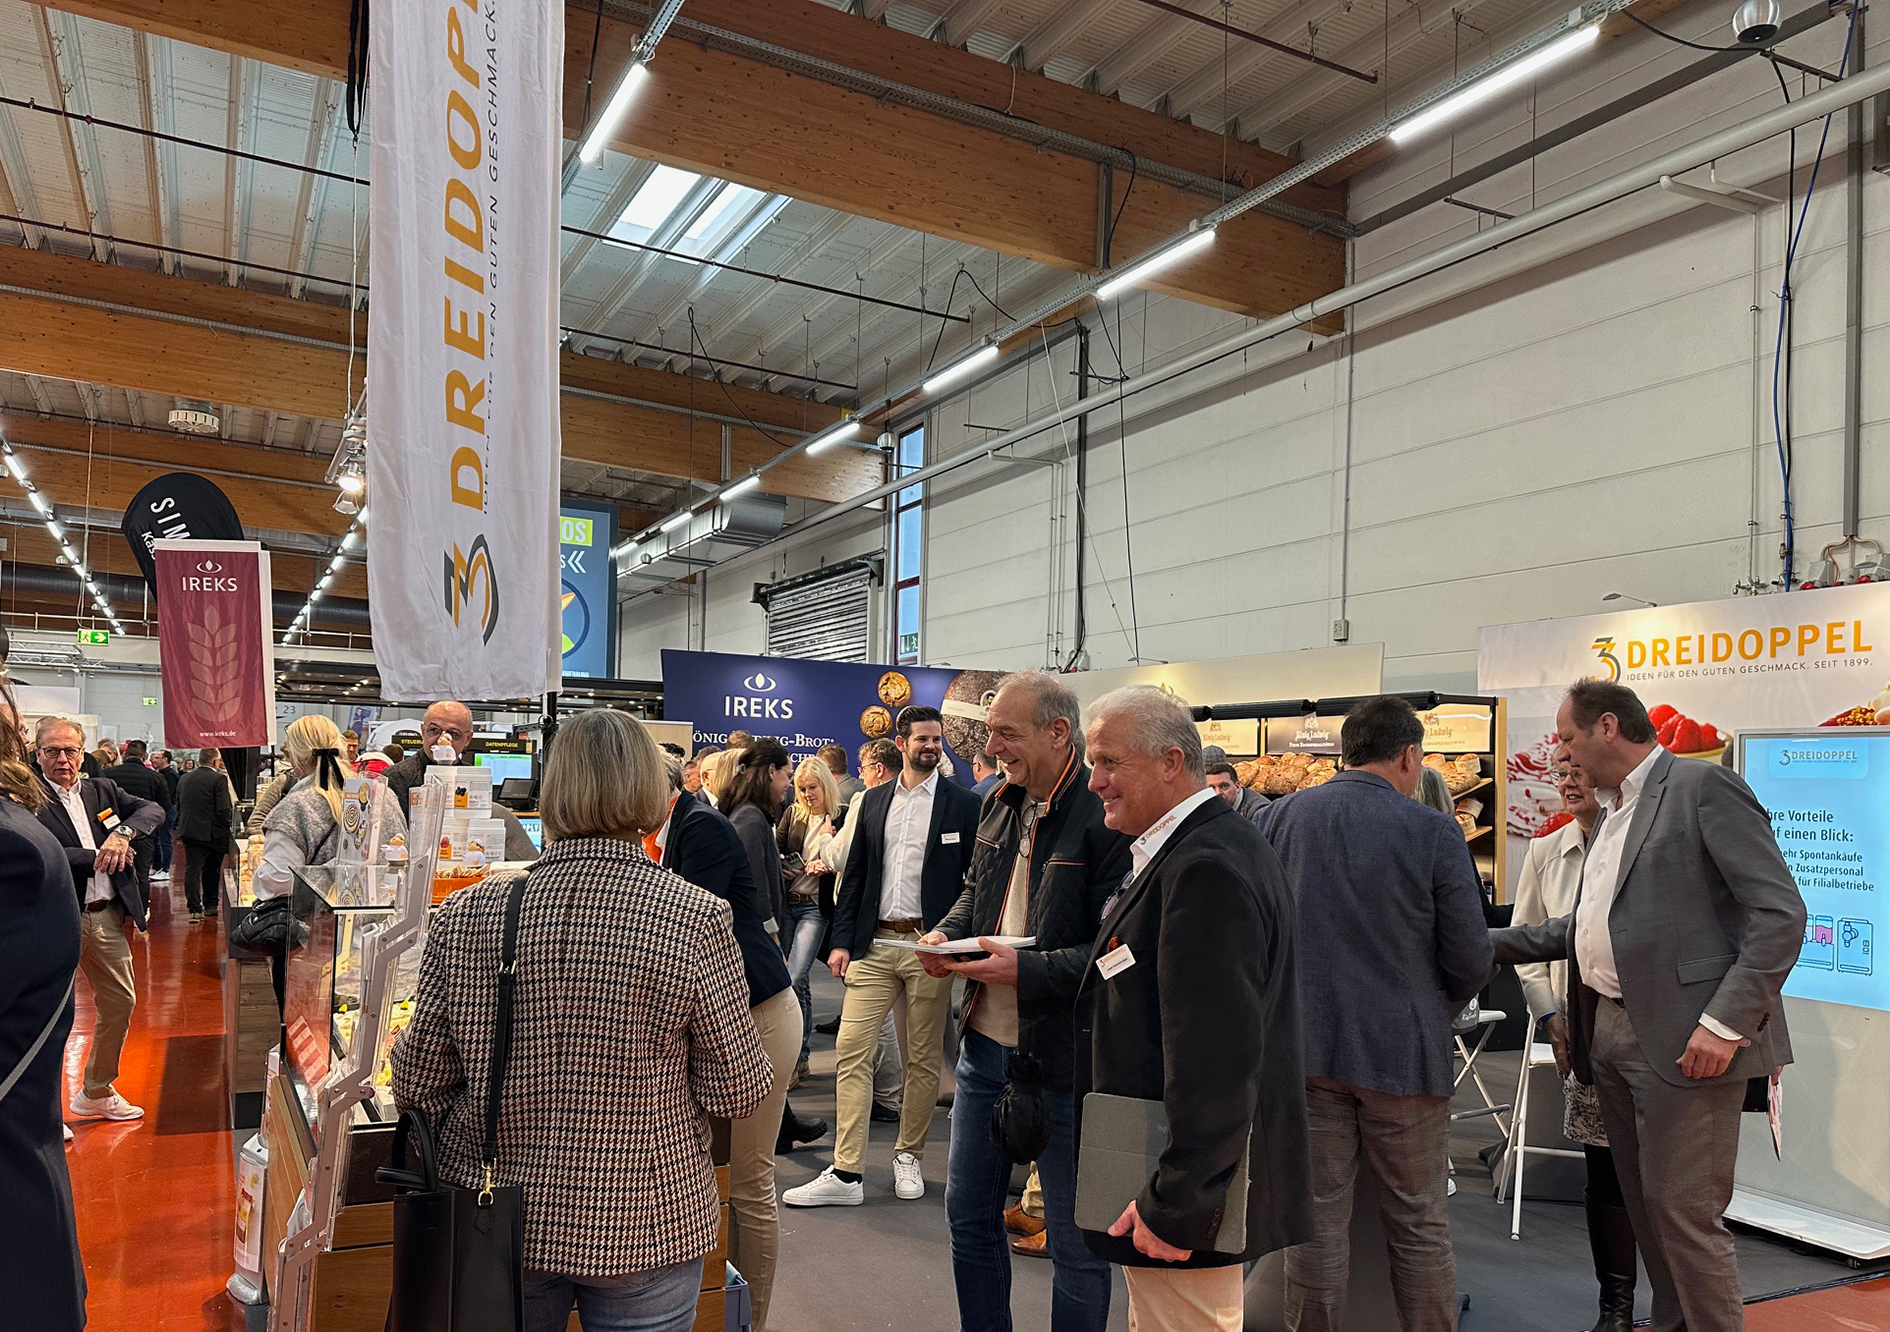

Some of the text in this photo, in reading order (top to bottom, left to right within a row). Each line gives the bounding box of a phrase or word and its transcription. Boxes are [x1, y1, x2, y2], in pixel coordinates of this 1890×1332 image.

[489, 195, 498, 289] GUTEN
[444, 0, 485, 512] DREIDOP
[182, 576, 238, 592] IREKS
[1627, 620, 1873, 669] DREIDOPPEL
[1626, 657, 1873, 681] IDEEN FÜR DEN GUTEN GESCHMACK. SEIT 1899.
[283, 705, 297, 715] 23
[724, 695, 793, 719] IREKS
[1792, 751, 1857, 760] DREIDOPPEL
[1788, 810, 1834, 823] Vorteile
[1784, 827, 1817, 840] einen
[1821, 828, 1854, 842] Blick:
[1782, 848, 1863, 863] ehr Spontankäufe
[1795, 863, 1864, 876] Zusatzpersonal
[1798, 877, 1875, 892] für Filialbetriebe
